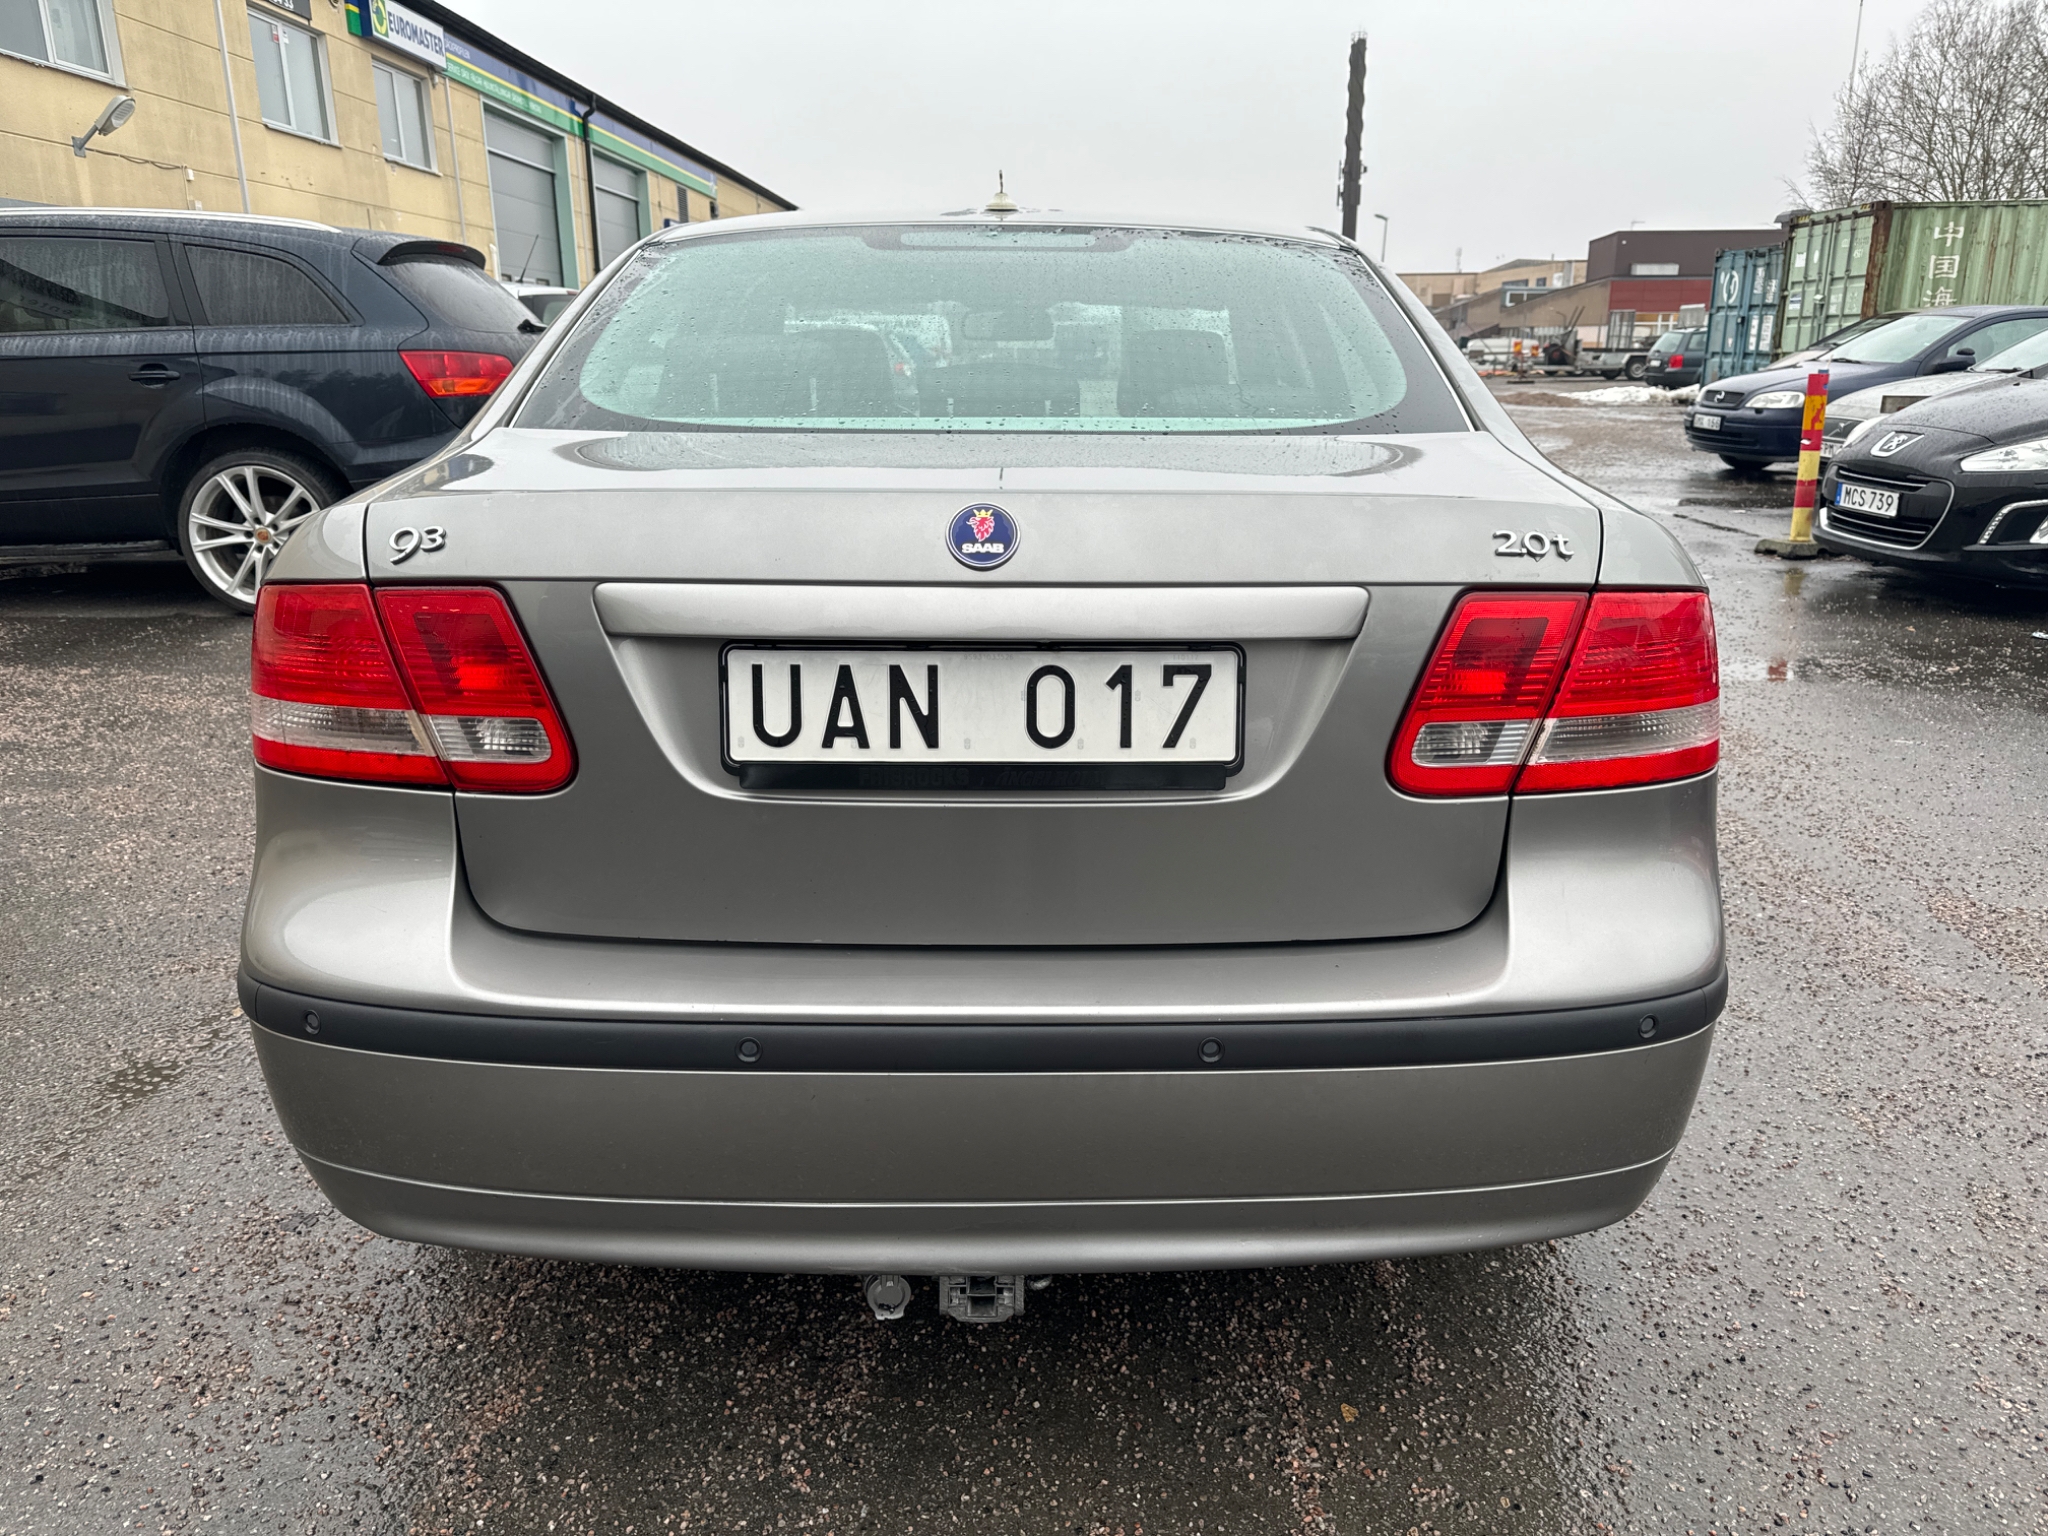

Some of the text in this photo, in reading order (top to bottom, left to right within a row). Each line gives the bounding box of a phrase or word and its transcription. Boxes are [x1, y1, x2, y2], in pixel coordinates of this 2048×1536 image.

[387, 11, 445, 57] EUROMASTER
[1843, 486, 1894, 512] MCS 739
[389, 525, 446, 566] 93
[961, 542, 1005, 554] SAAB
[1492, 529, 1575, 561] 2.0t
[750, 663, 1213, 750] UAN 017
